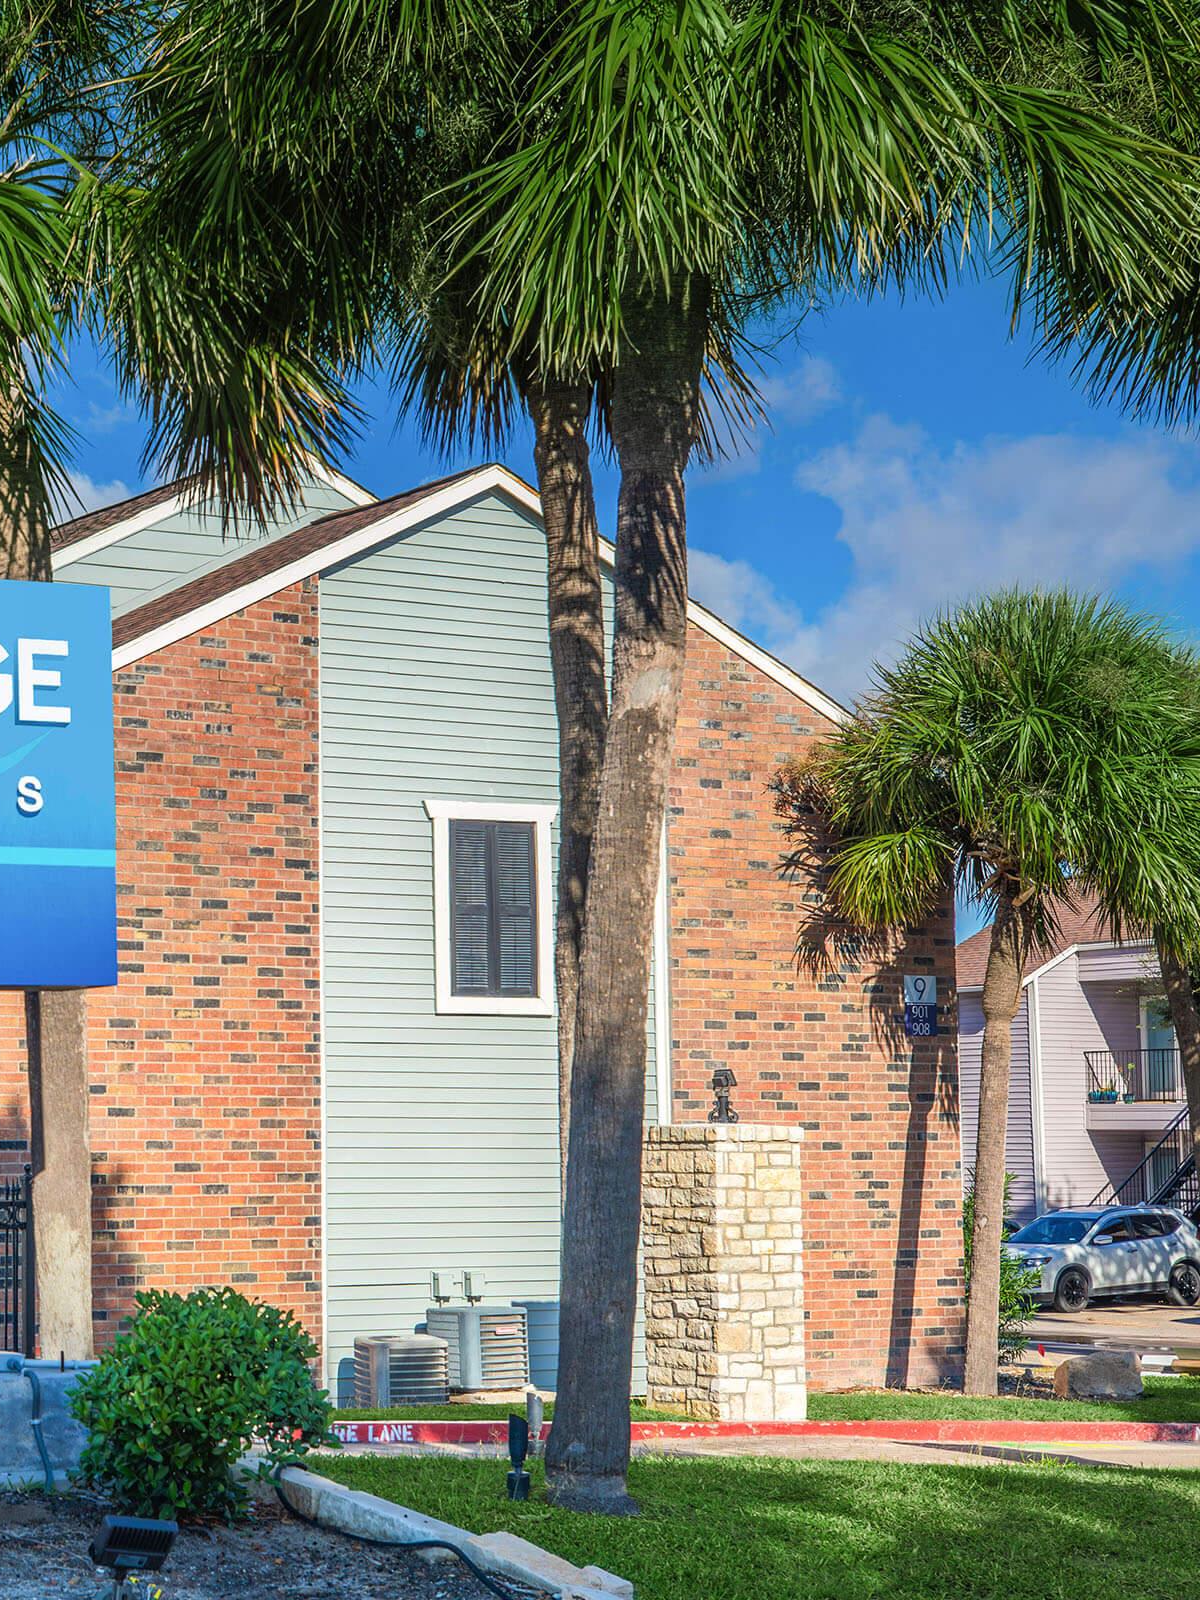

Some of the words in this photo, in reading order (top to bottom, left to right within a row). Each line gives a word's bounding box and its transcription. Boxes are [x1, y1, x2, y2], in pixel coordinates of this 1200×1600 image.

[913, 977, 926, 1001] 9
[912, 1005, 929, 1018] 901
[912, 1022, 930, 1036] 908
[368, 1424, 414, 1442] LANE
